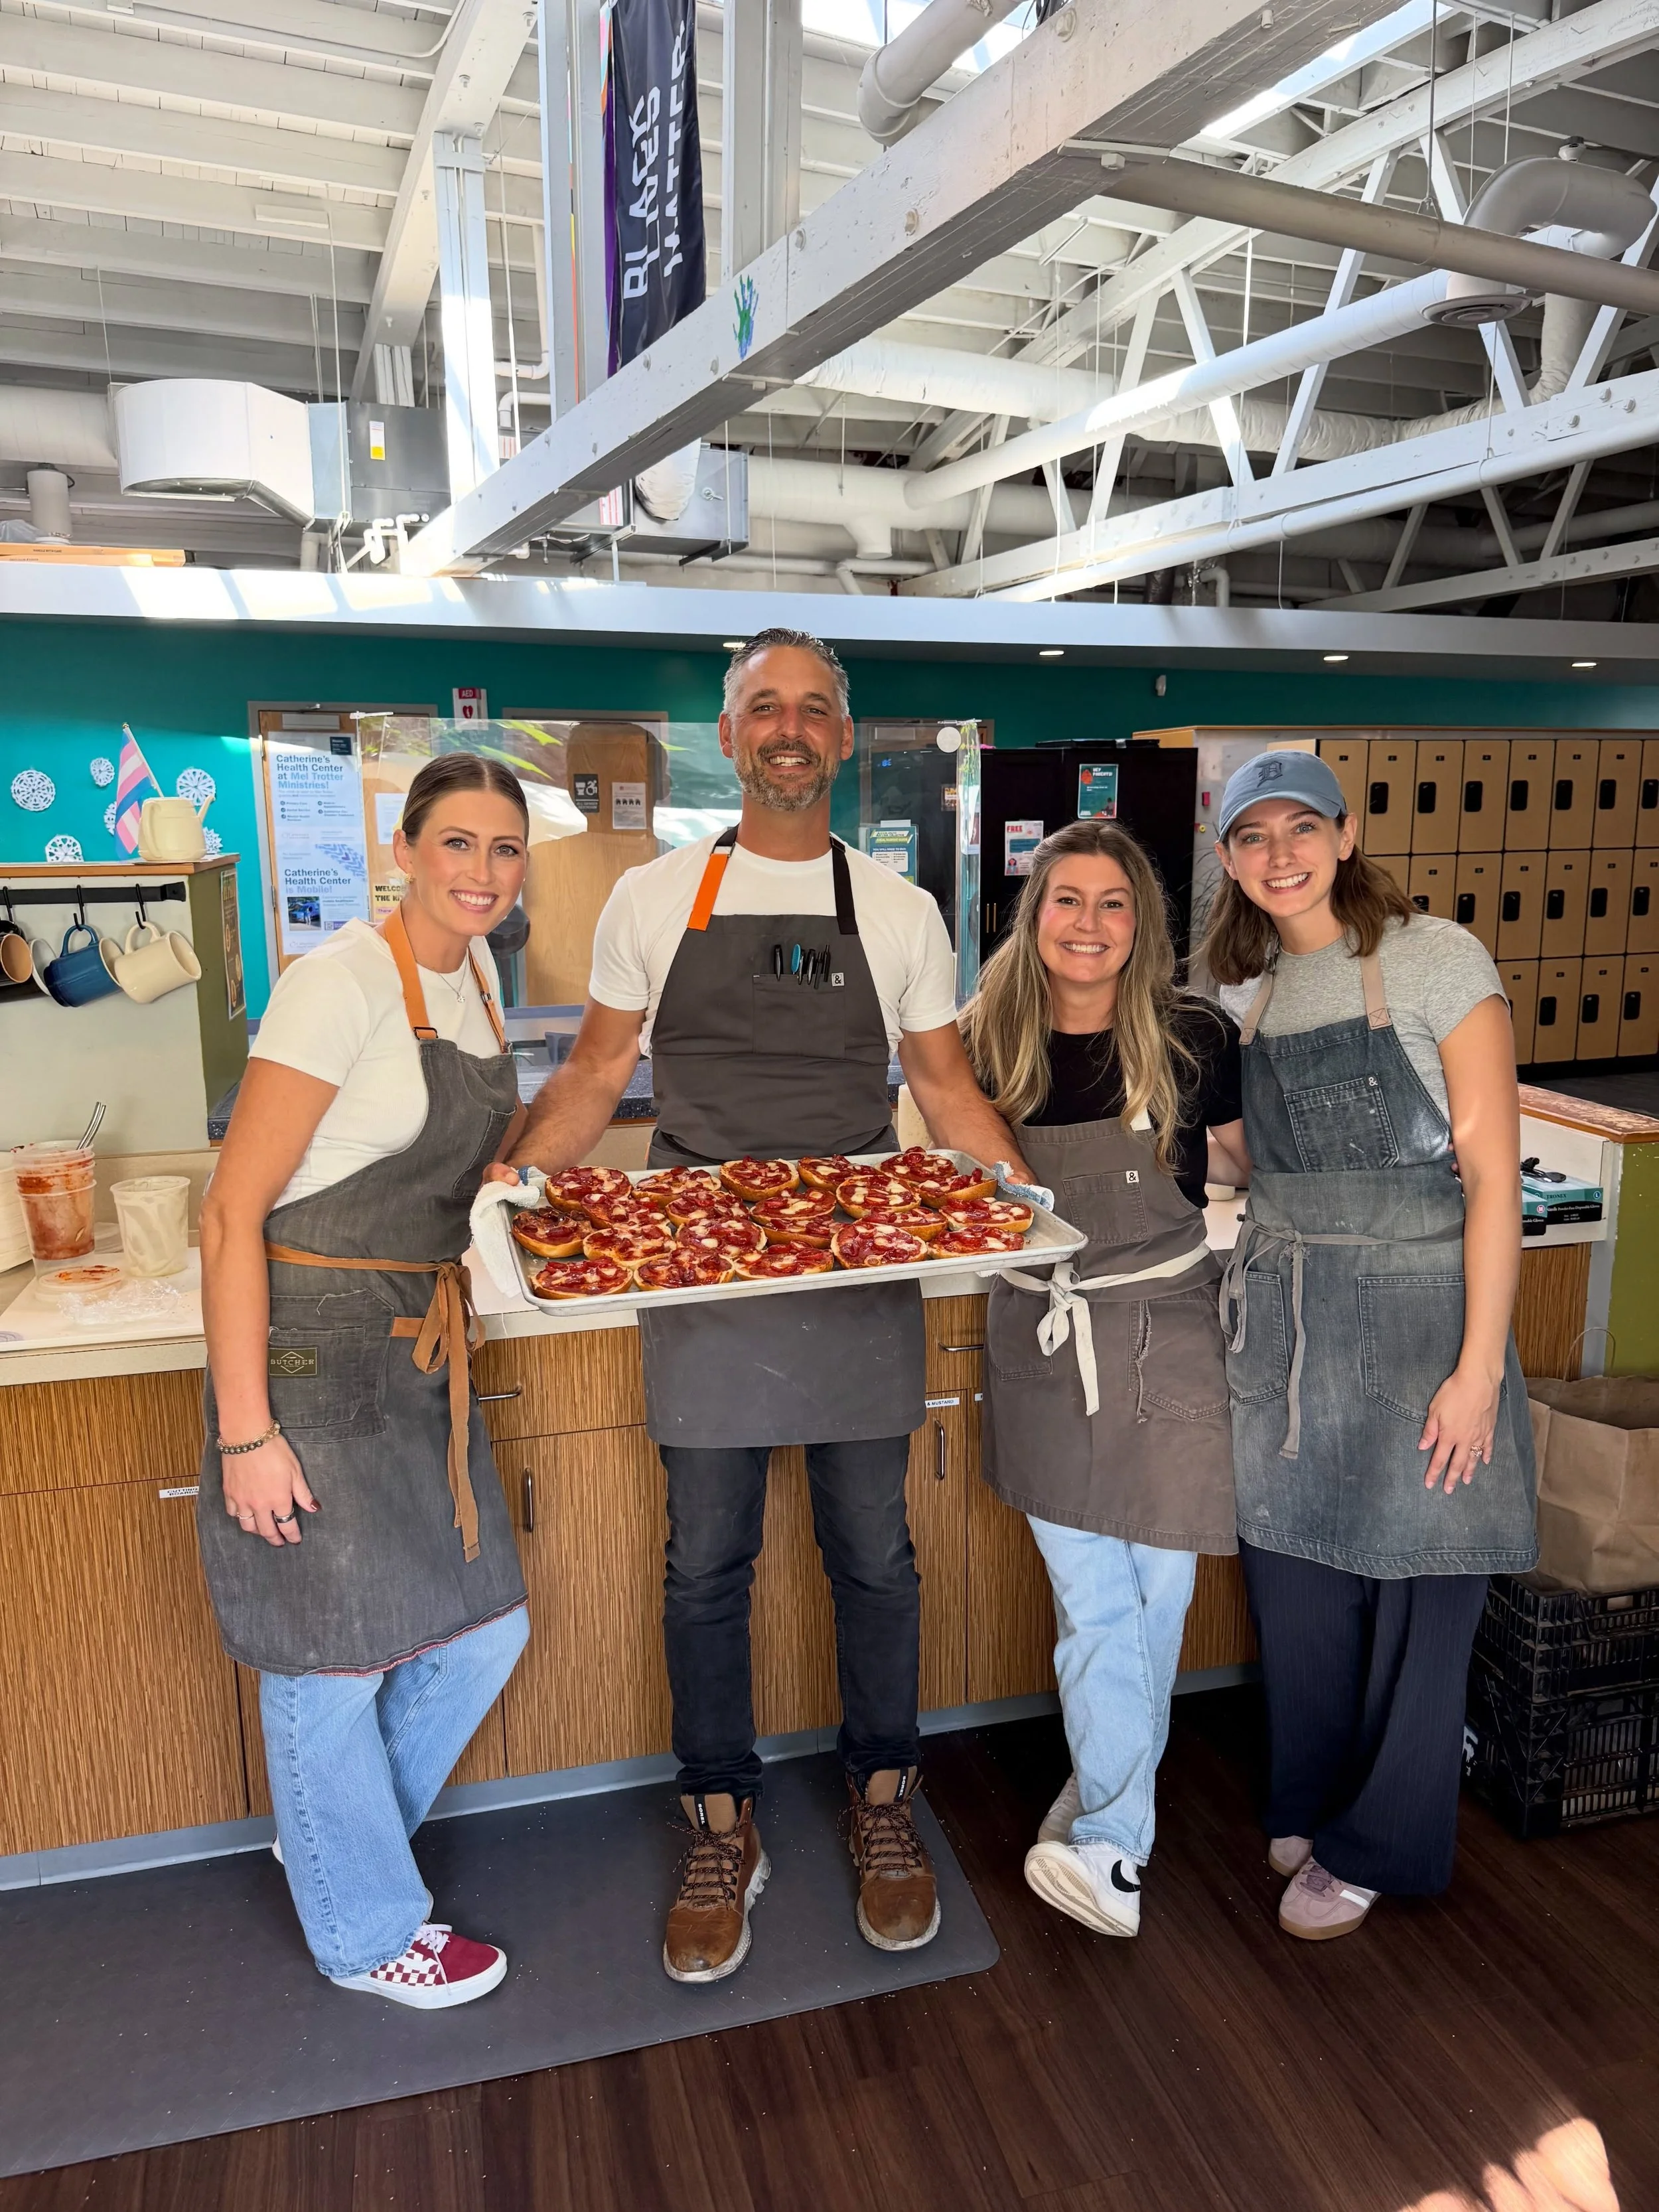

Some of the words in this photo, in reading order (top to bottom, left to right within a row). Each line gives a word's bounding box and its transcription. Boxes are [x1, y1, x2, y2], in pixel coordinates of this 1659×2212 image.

[276, 755, 330, 763] Catherine's
[285, 868, 338, 877] Catherine's
[835, 975, 841, 984] &
[1368, 1076, 1378, 1086] &
[1129, 1172, 1136, 1181] &
